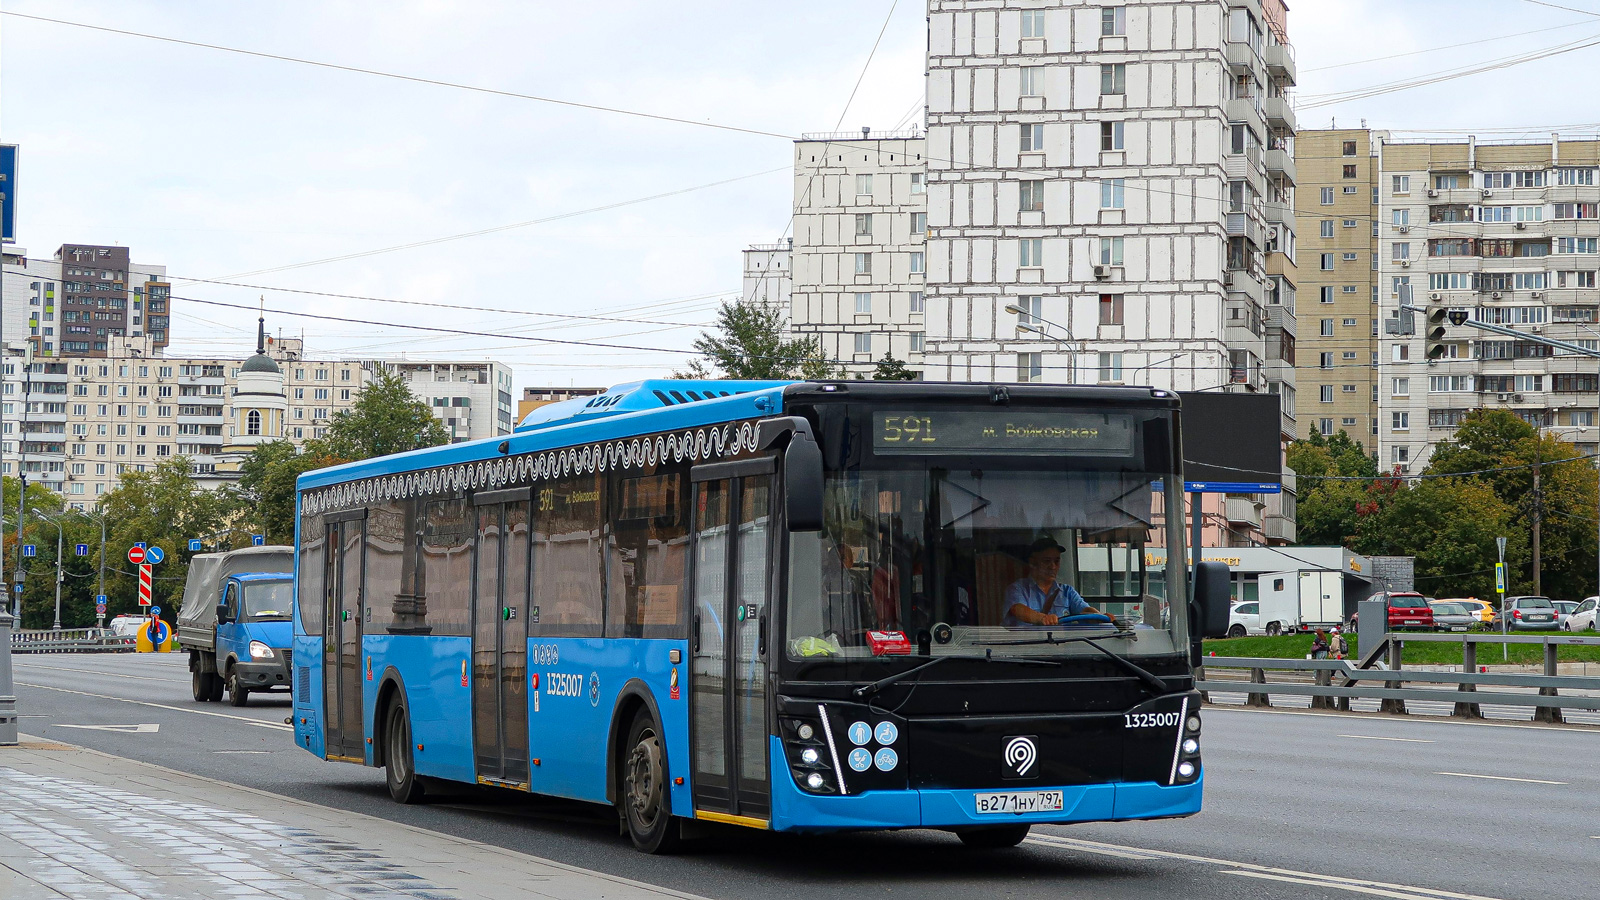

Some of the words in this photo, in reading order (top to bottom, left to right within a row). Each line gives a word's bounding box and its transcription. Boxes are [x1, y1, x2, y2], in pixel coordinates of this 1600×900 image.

[884, 416, 936, 442] 591
[1006, 423, 1098, 438] Войковская
[540, 489, 554, 511] 591
[547, 672, 583, 697] 1325007
[1125, 713, 1180, 728] 1325007
[1039, 793, 1060, 805] 797
